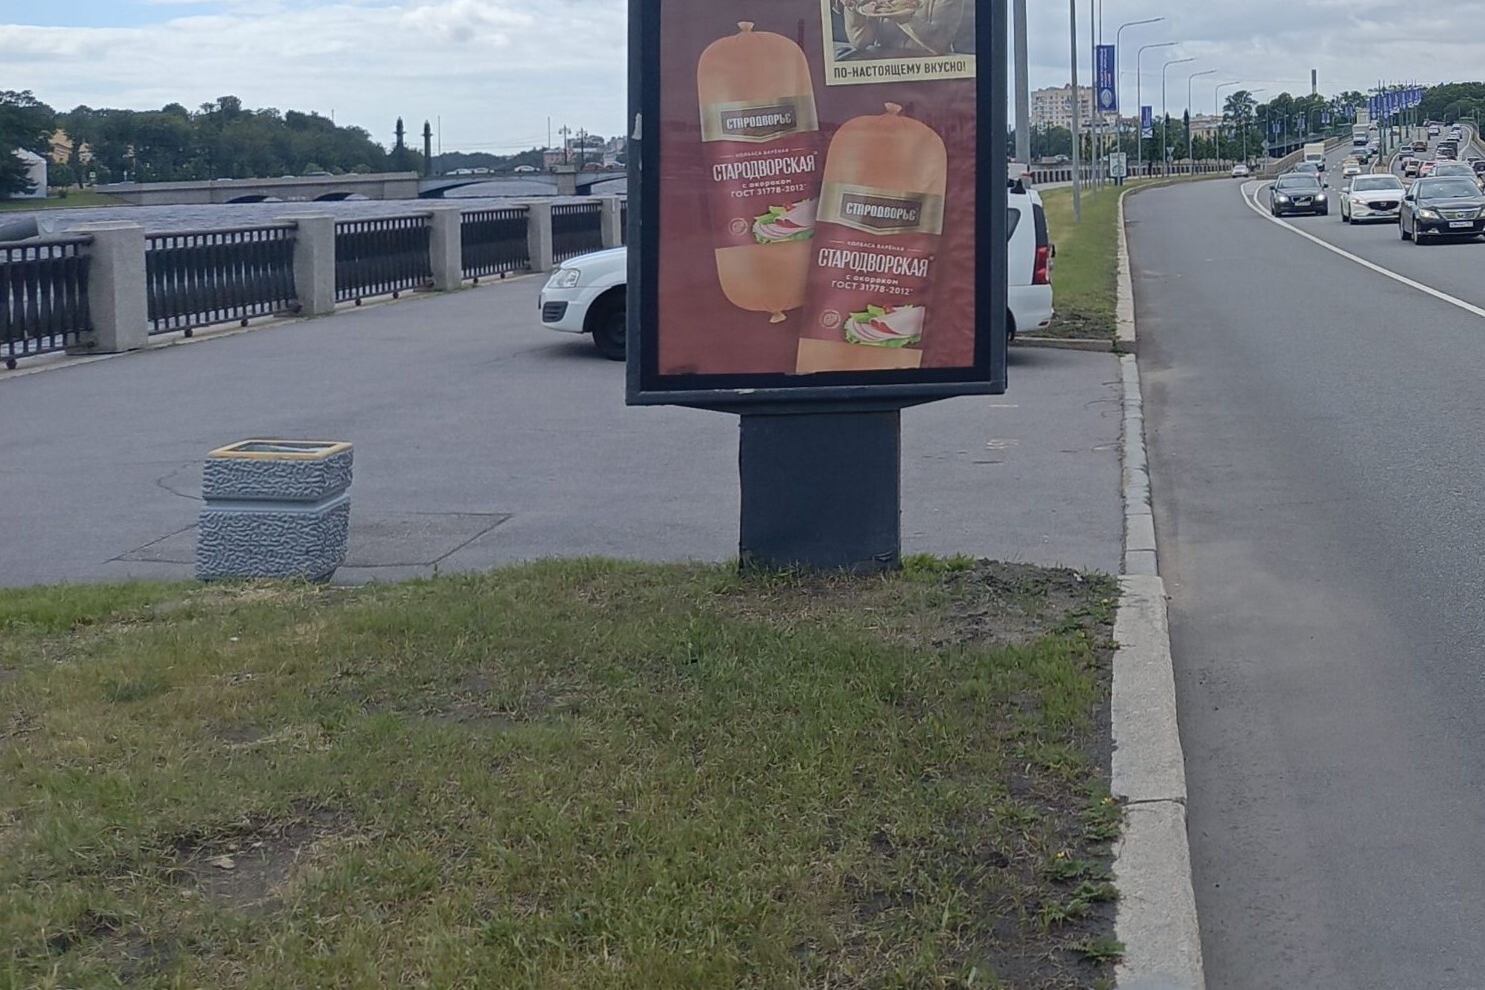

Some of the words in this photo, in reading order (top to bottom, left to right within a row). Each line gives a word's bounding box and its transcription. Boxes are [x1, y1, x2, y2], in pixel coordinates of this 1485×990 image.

[834, 63, 921, 78] ПО-НАСТОЯЩЕМУ
[924, 61, 966, 73] ВКУСНО!
[712, 155, 815, 182] СТАРОДВОРСКАЯ
[750, 178, 792, 188] окороком
[731, 189, 754, 198] ГОСТ
[818, 248, 929, 277] СТАРОДВОРСКАЯ
[831, 280, 857, 289] ГОСТ
[853, 275, 898, 285] окороком
